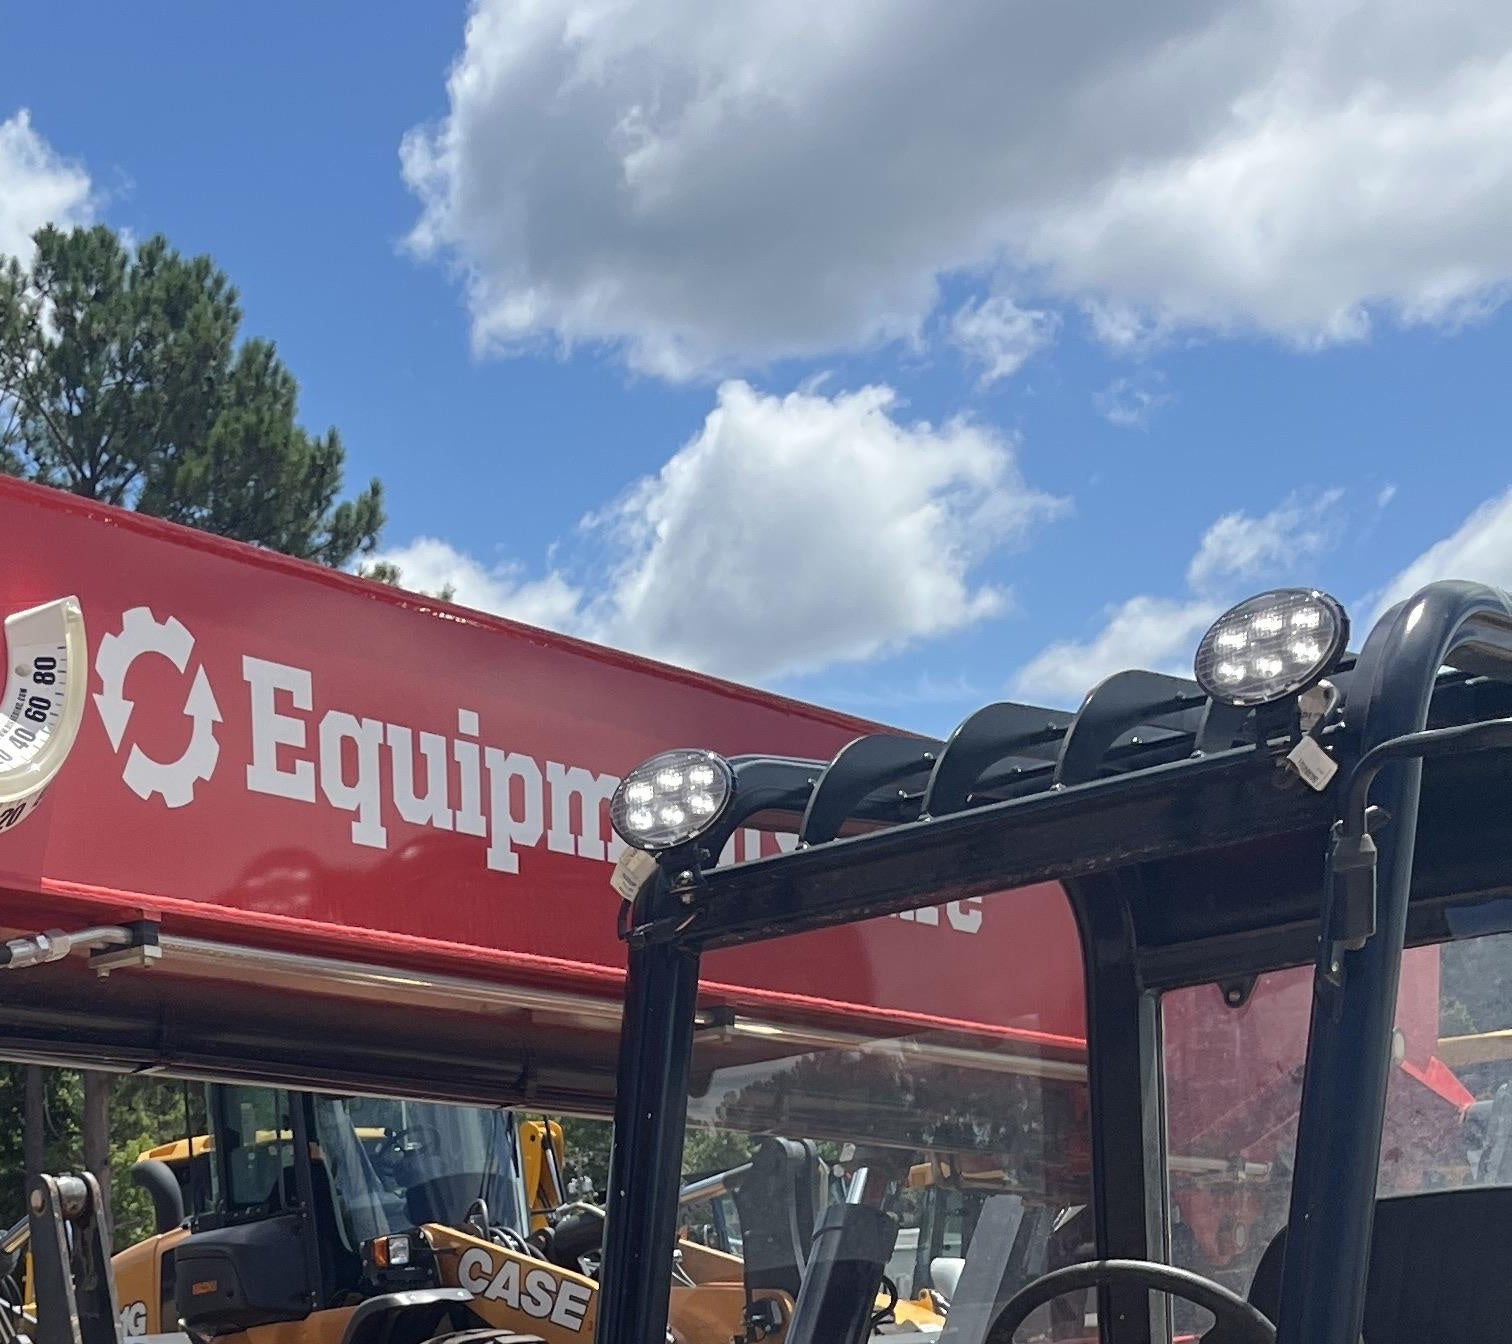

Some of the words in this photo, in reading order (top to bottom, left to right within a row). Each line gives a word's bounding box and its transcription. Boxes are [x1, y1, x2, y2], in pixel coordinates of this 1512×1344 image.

[33, 656, 57, 686] 80
[24, 695, 52, 723] 60
[457, 1246, 593, 1332] CASE
